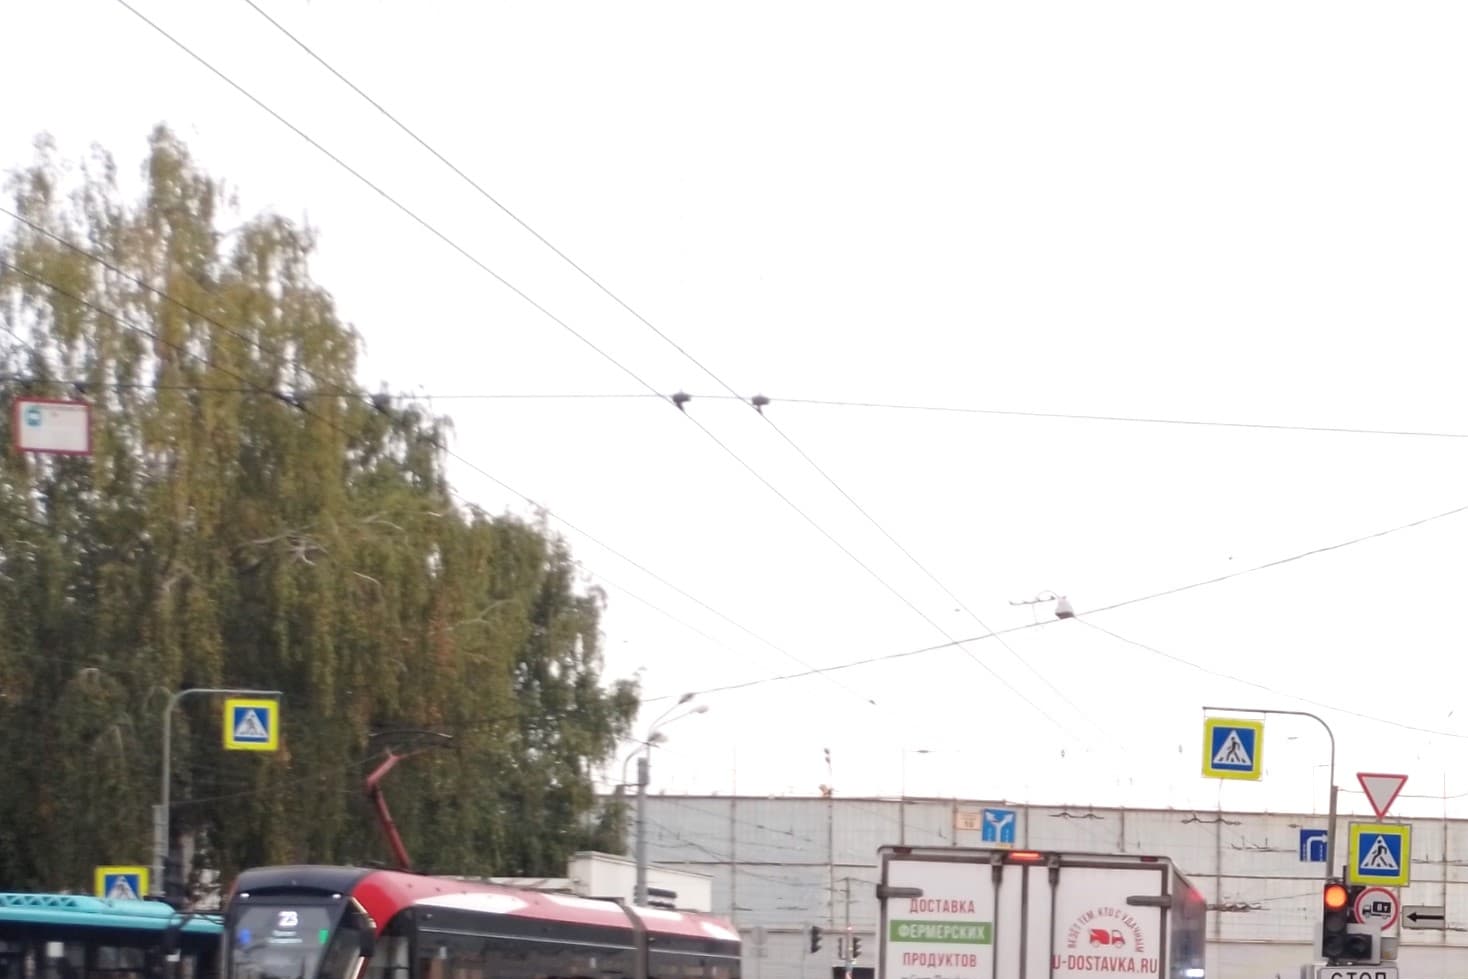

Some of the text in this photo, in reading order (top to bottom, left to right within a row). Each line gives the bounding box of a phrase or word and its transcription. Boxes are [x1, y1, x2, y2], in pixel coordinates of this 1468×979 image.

[910, 898, 975, 913] ДОСТАВКА
[278, 911, 298, 926] 23
[898, 924, 985, 940] ФЕРМЕРСКИХ
[903, 952, 977, 968] ПРОДУКТОВ
[1052, 955, 1158, 974] U-DOSTAVKA.RU
